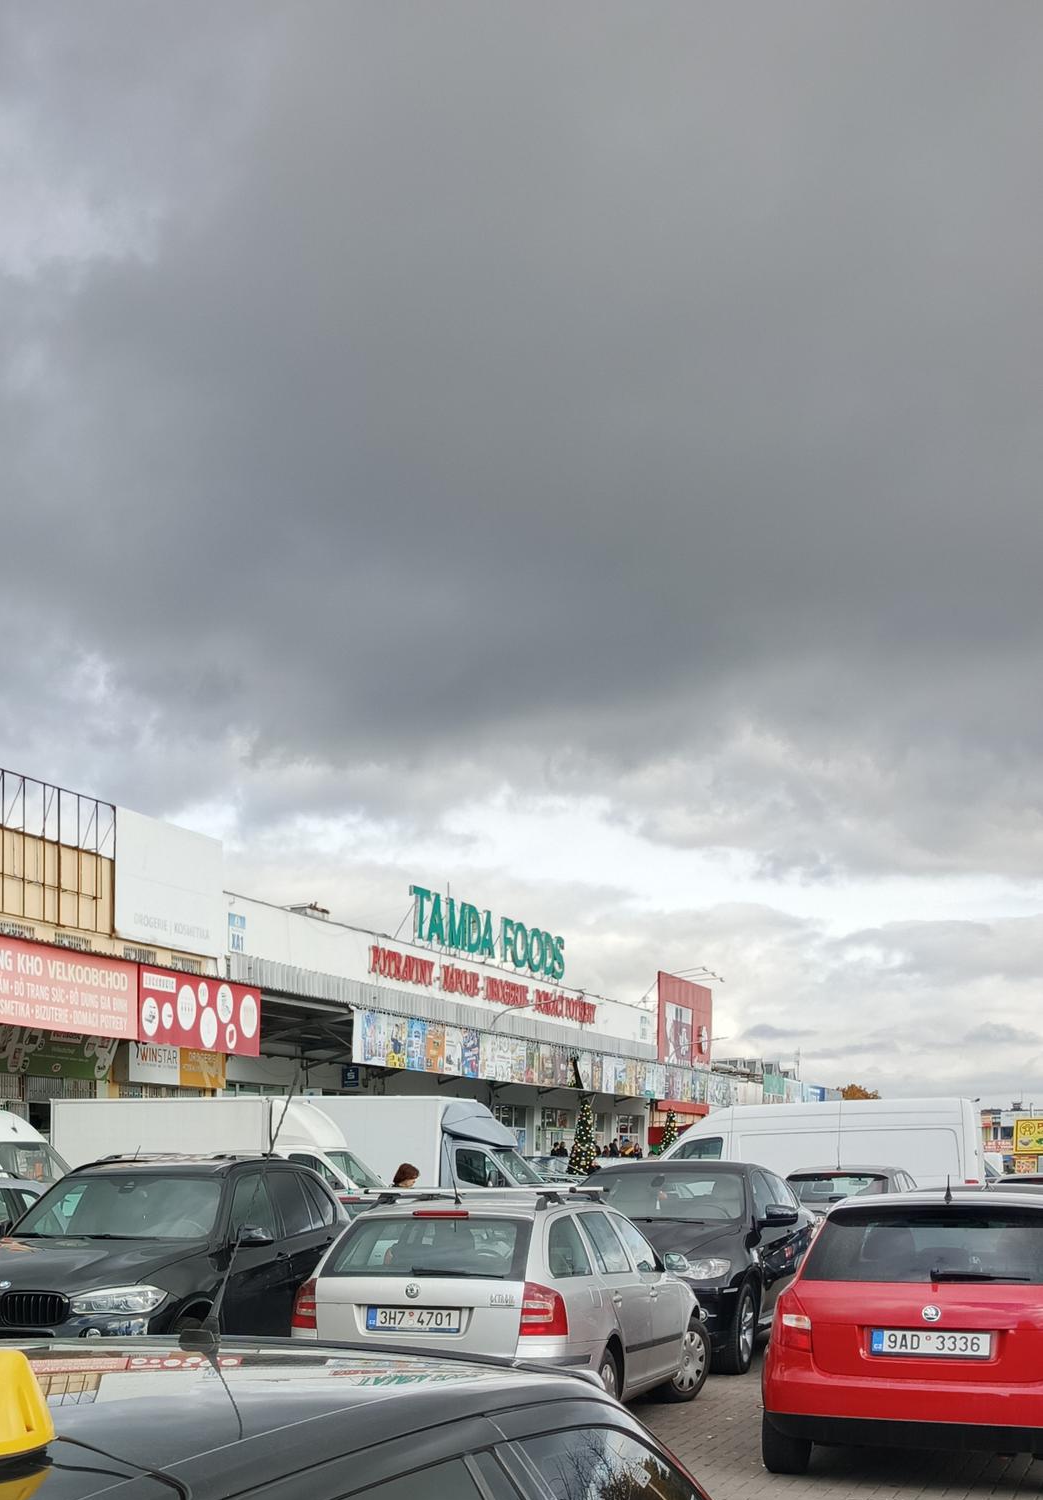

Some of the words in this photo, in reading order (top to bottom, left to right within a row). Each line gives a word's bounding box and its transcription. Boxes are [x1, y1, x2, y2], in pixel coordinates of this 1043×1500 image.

[409, 884, 495, 959] TAMDA
[500, 916, 565, 980] FOODS
[17, 952, 43, 977] KHO
[47, 959, 128, 991] VELKOOBCHOD
[368, 945, 435, 986] POTRAVINY
[483, 975, 529, 1008] DROGERIE
[25, 981, 50, 1001] TRANG
[379, 1311, 406, 1325] 3H7
[417, 1312, 452, 1326] 4701
[888, 1333, 920, 1350] 9AD
[935, 1335, 980, 1352] 3336
